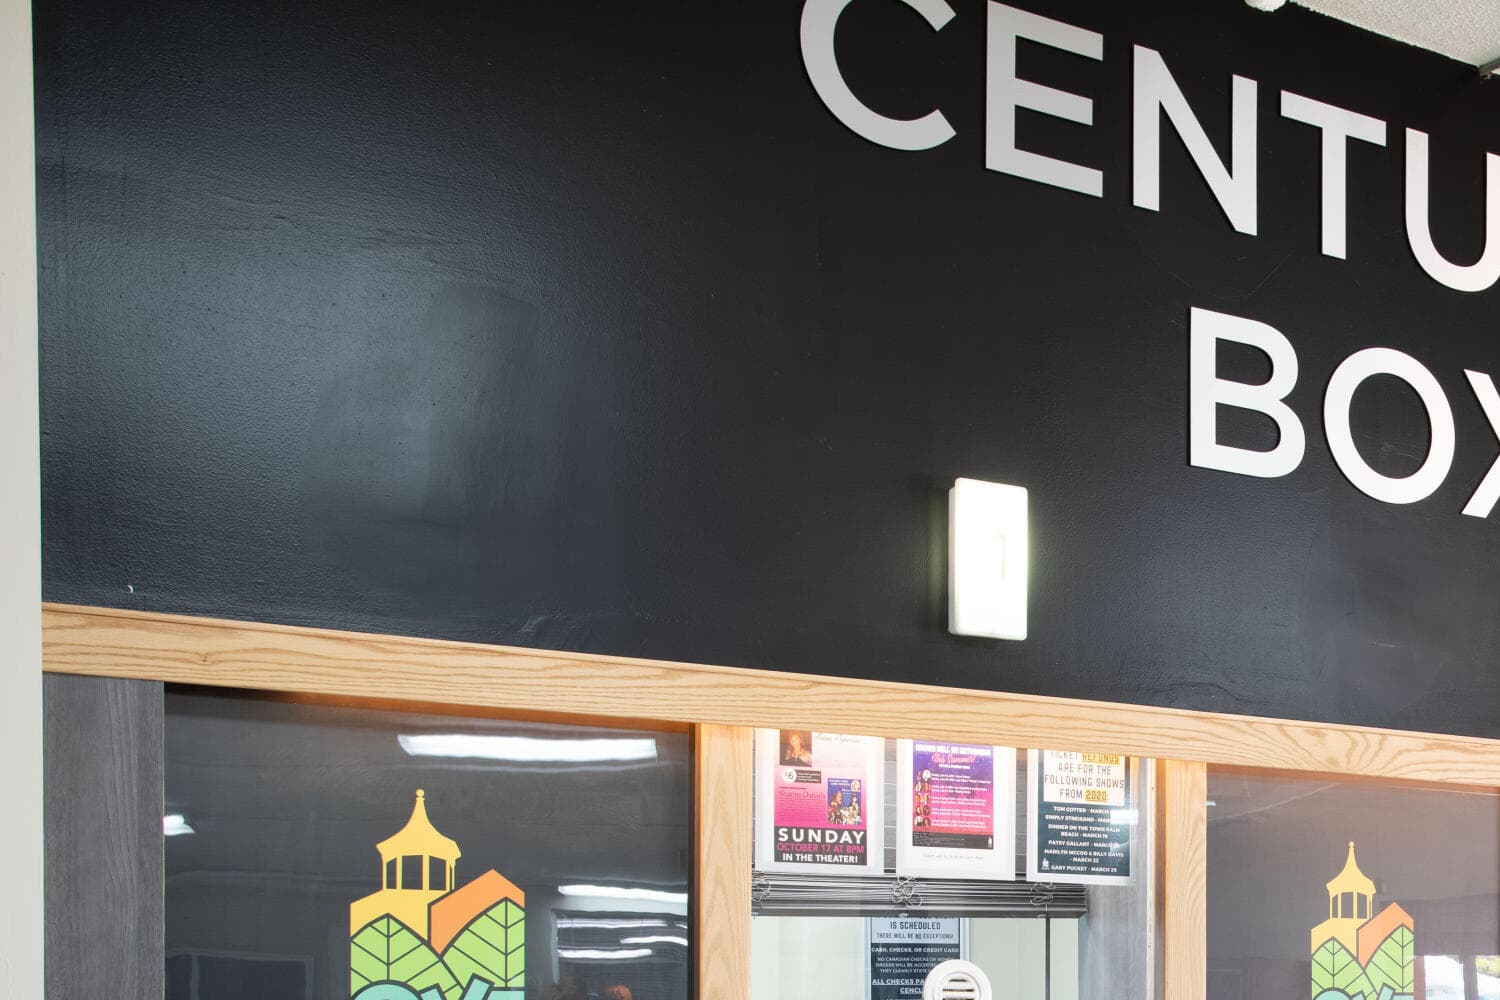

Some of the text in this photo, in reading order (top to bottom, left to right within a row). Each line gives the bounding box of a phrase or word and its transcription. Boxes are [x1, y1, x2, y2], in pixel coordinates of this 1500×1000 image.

[1082, 752, 1120, 763] REFUNDS
[1058, 763, 1111, 775] ARE FOR THE
[1044, 775, 1125, 789] FOLLOWING SHOWS
[1060, 789, 1083, 799] FROM
[778, 828, 864, 844] SUNDAY
[776, 842, 818, 852] OCTOBER
[822, 844, 830, 853] 17
[834, 845, 843, 853] AT
[783, 853, 858, 863] IN THE THEATER!
[900, 922, 941, 930] SCHEDULED
